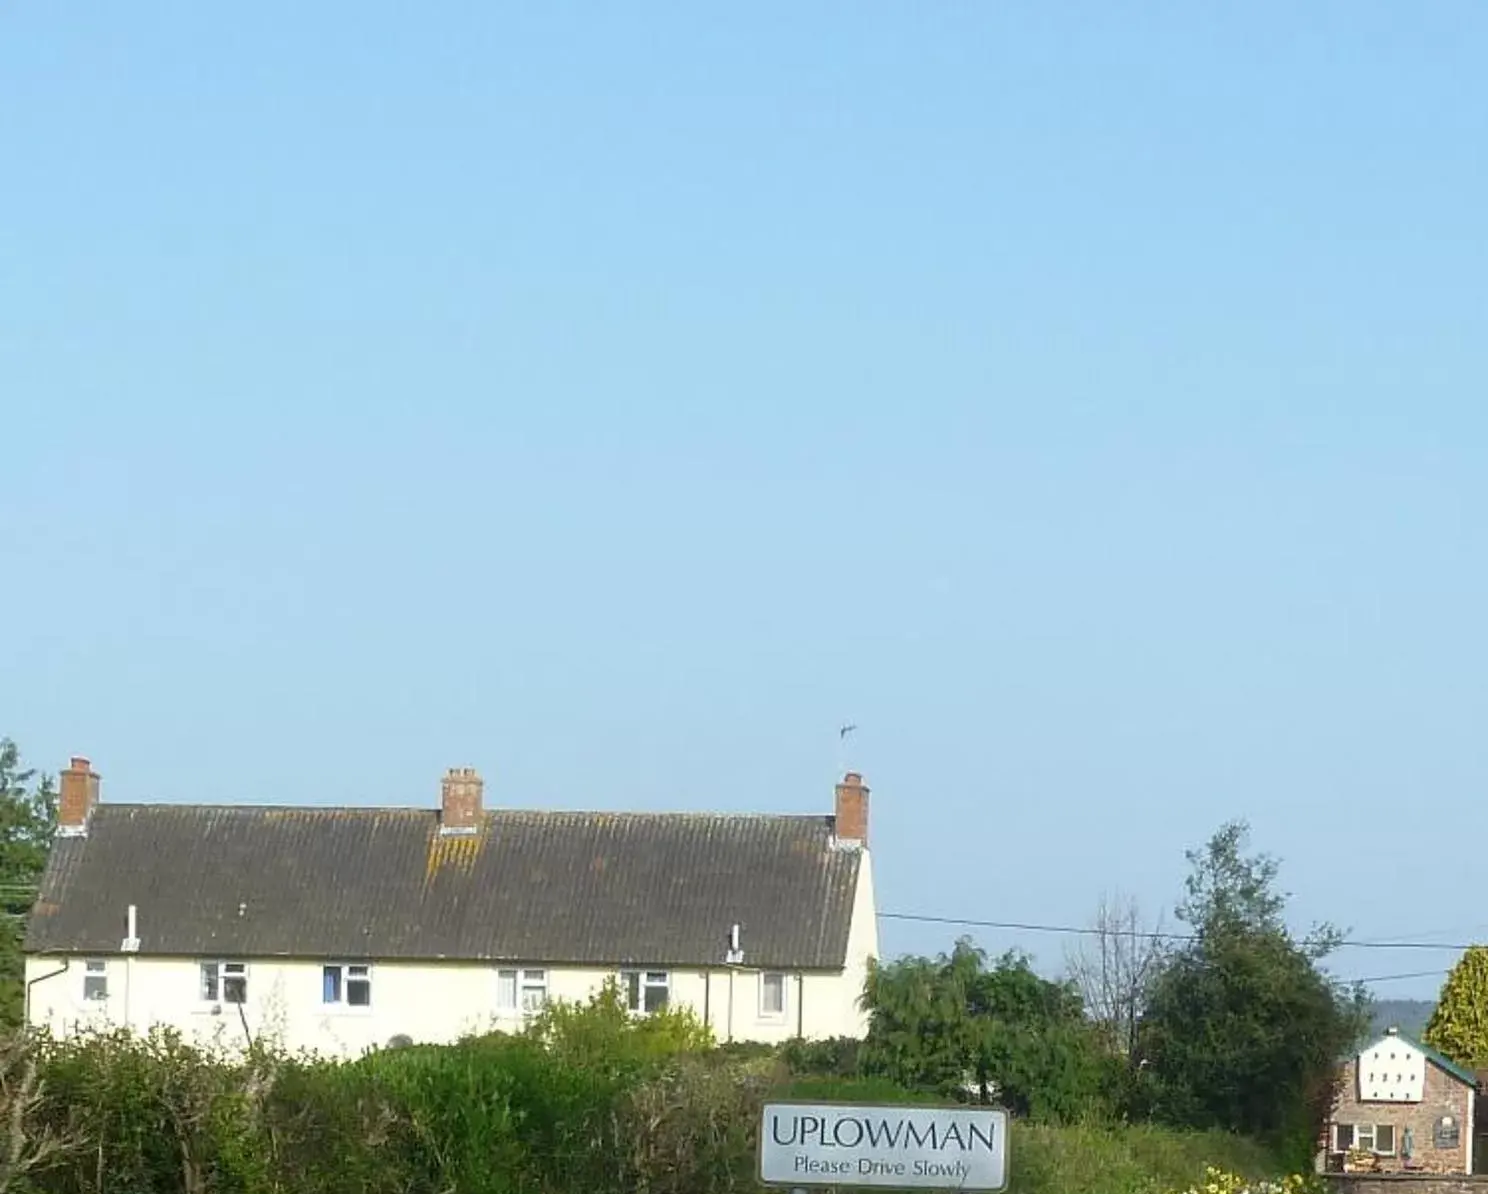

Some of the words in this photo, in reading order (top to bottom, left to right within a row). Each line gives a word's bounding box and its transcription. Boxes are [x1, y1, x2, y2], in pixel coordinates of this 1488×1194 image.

[772, 1115, 995, 1152] UPLOWMAN
[794, 1155, 850, 1174] Please
[858, 1158, 905, 1177] Drive
[912, 1160, 972, 1180] Slowly
